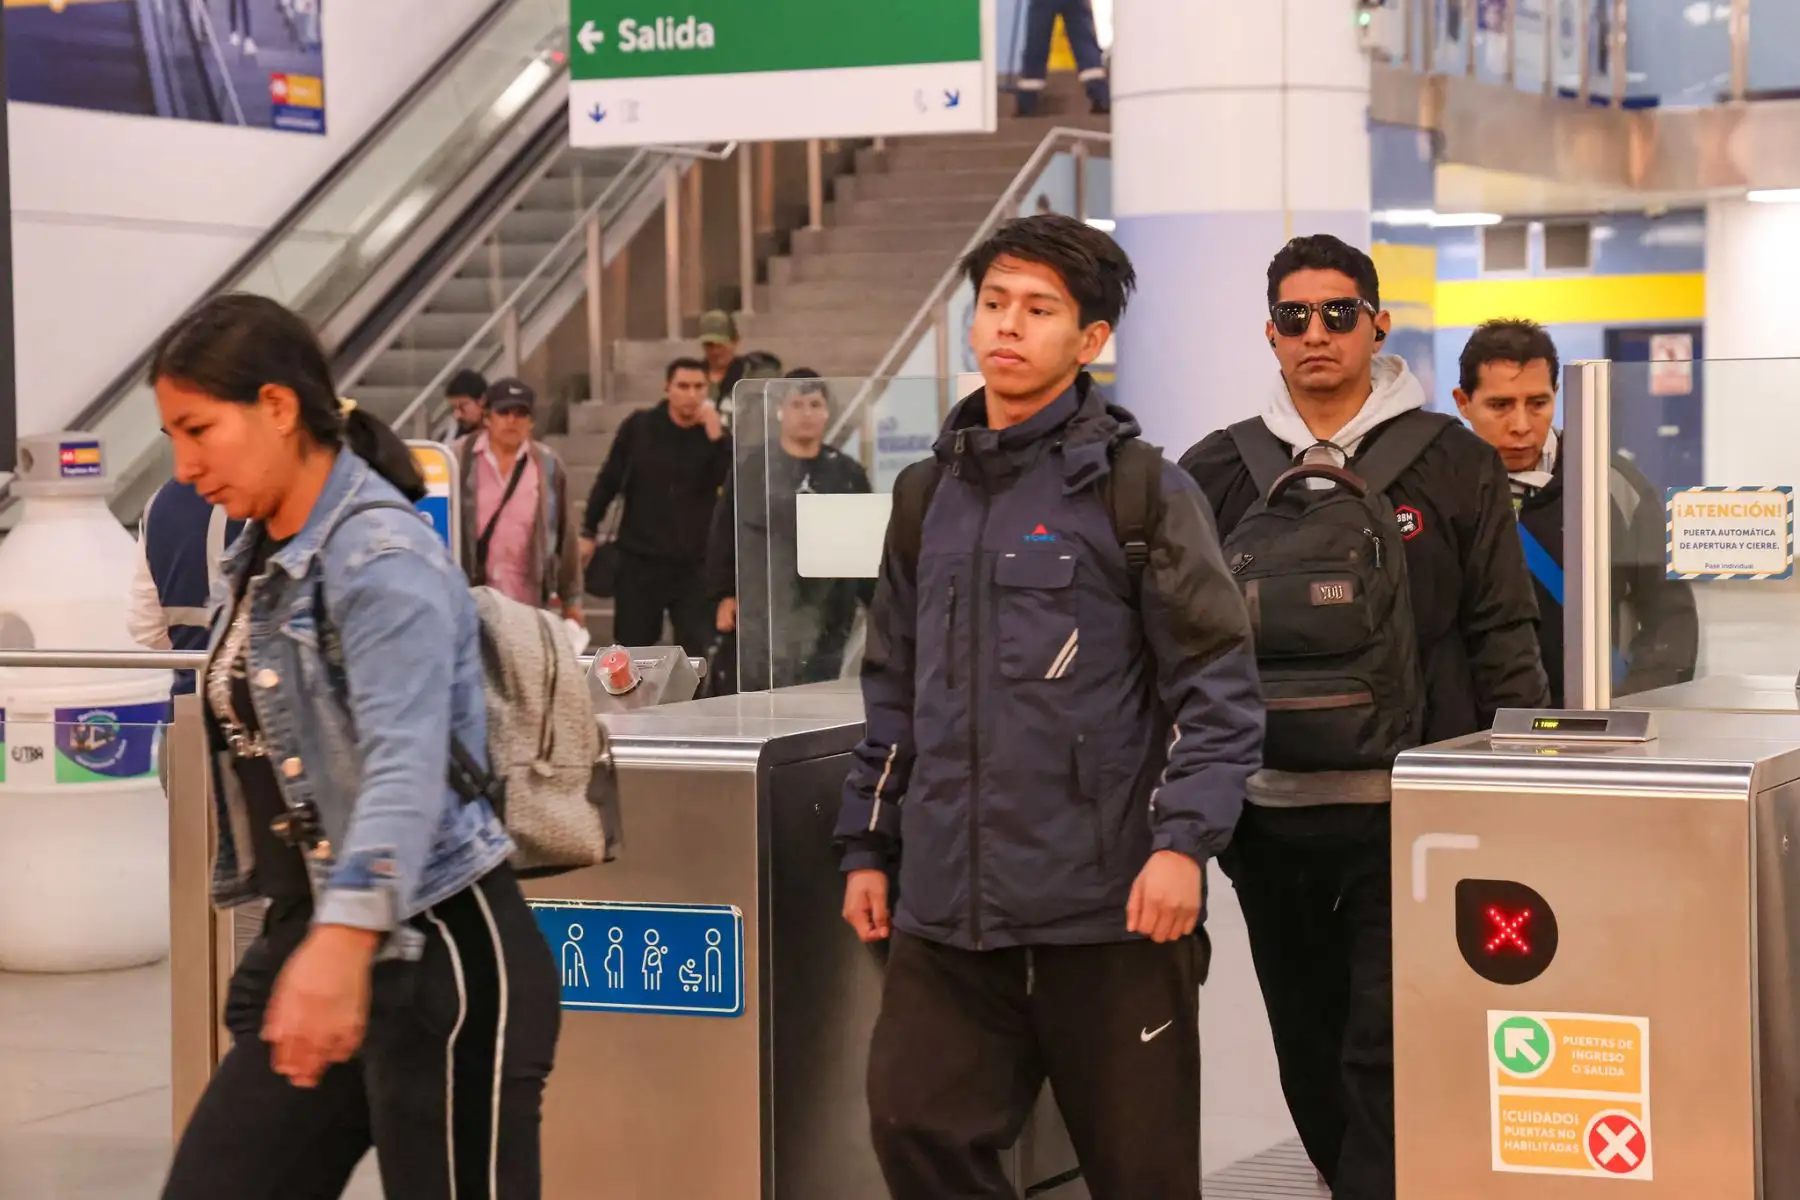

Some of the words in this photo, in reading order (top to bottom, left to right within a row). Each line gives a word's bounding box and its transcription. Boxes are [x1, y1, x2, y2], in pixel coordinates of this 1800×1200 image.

[618, 15, 715, 52] Salida
[1677, 501, 1782, 518] ¡ATENCIÓN!
[1683, 529, 1718, 537] PUERTA
[1718, 527, 1776, 537] AUTOMÁTICA
[1680, 542, 1692, 550] DE
[1693, 542, 1737, 550] APERTURA
[1739, 542, 1745, 550] Y
[1746, 542, 1780, 550] CIERRE.
[1562, 1035, 1615, 1049] PUERTAS
[1617, 1039, 1634, 1050] DE
[1571, 1050, 1625, 1063] INGRESO
[1571, 1064, 1581, 1074] O
[1583, 1064, 1626, 1076] SALIDA
[1504, 1125, 1555, 1139] PUERTAS
[1557, 1129, 1576, 1140] NO
[1504, 1140, 1580, 1154] HABILITADAS
